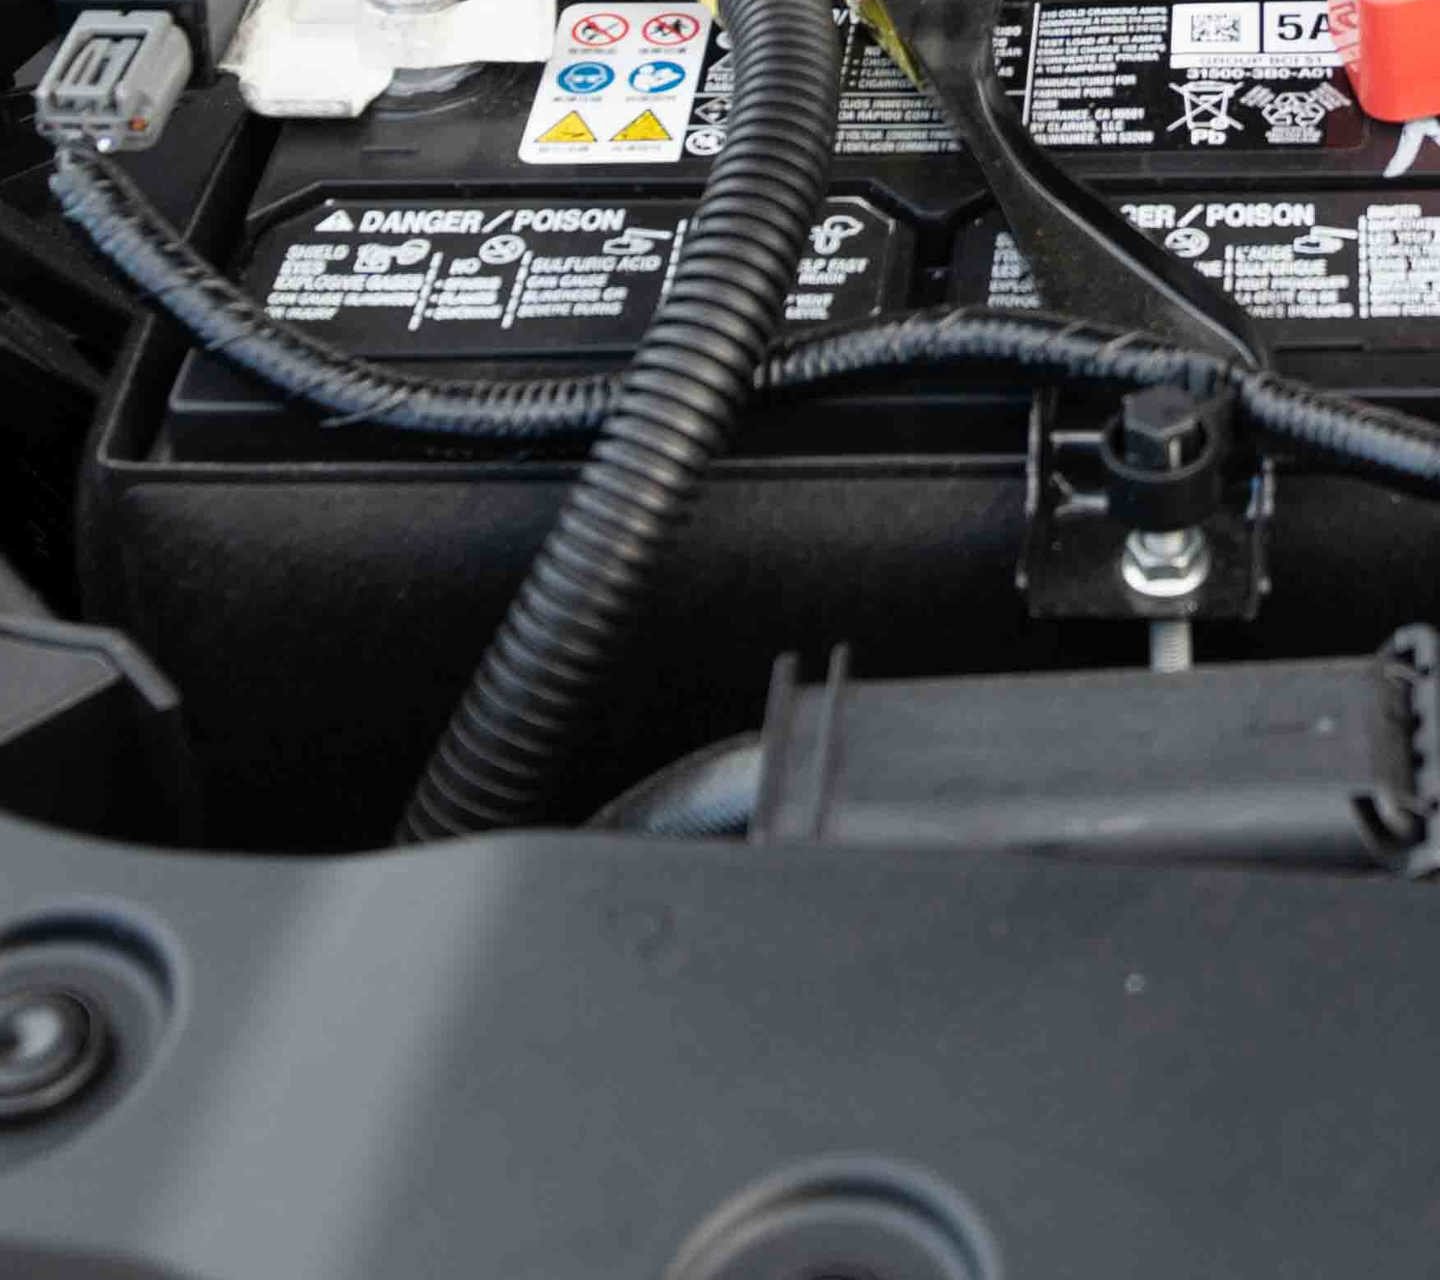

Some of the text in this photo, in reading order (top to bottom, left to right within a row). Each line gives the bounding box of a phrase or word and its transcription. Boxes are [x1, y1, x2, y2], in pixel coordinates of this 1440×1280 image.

[1058, 8, 1086, 18] COLD
[1066, 36, 1096, 47] LOAD
[1097, 35, 1111, 45] AT
[1116, 74, 1138, 86] FOR
[1094, 108, 1111, 120] CA
[1190, 128, 1228, 146] Pb
[449, 257, 482, 276] NO
[529, 255, 663, 274] SULFURIC ACID
